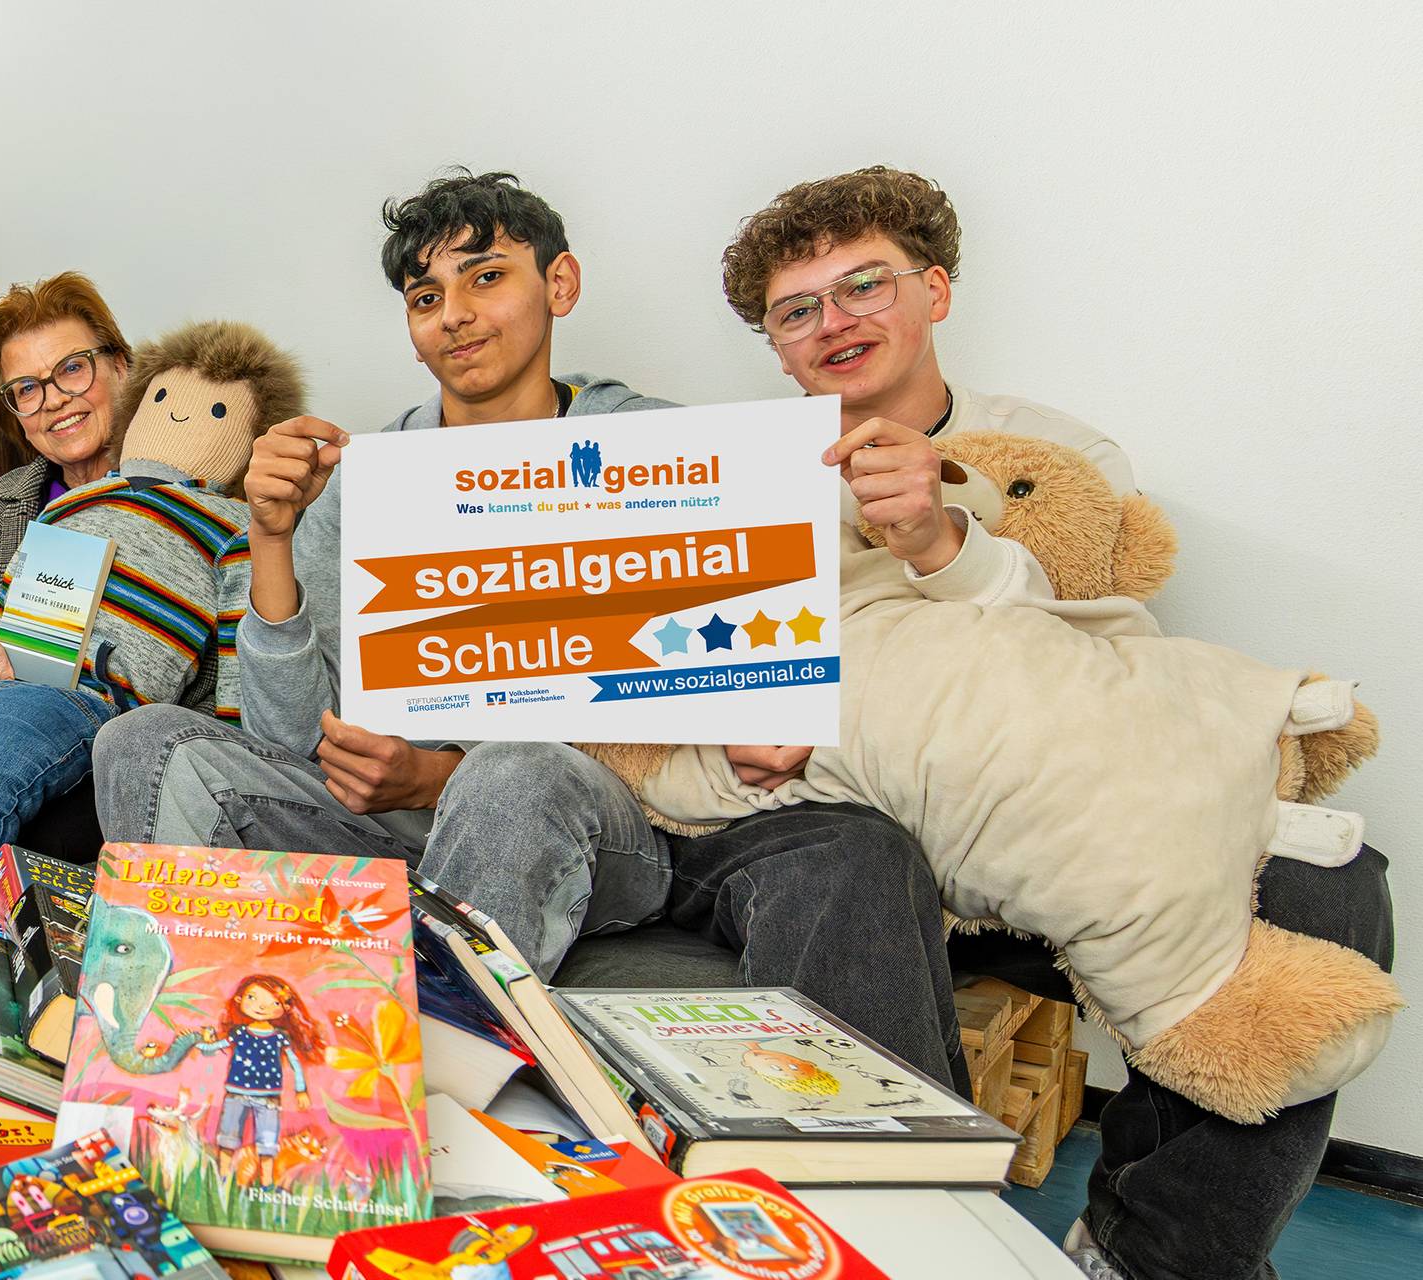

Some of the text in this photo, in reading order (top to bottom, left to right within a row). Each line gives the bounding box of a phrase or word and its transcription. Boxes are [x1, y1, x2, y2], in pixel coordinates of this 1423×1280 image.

[455, 455, 720, 494] sozial genial
[456, 496, 721, 514] Was kannst du gut was anderen nützt?
[414, 532, 750, 600] sozialgenial
[36, 571, 75, 590] tschick
[21, 592, 81, 615] WOLFGANG HERRNDORF
[417, 626, 594, 679] Schule
[616, 662, 826, 697] www.sozialgenial.de
[406, 694, 470, 705] STIFTUNG AKTIVE
[508, 688, 550, 697] Volksbanken
[509, 694, 566, 705] Raiffeisenbanken
[408, 701, 470, 713] BÜRGERSCHAFT
[118, 858, 240, 889] Liliane
[290, 874, 387, 890] Tanya Stewner
[146, 887, 326, 924] Susewind
[145, 921, 391, 950] Mit Elefanten spricht man nicht!
[656, 1021, 823, 1037] geniale Welt
[248, 1186, 410, 1219] Fischer Schatzinsel
